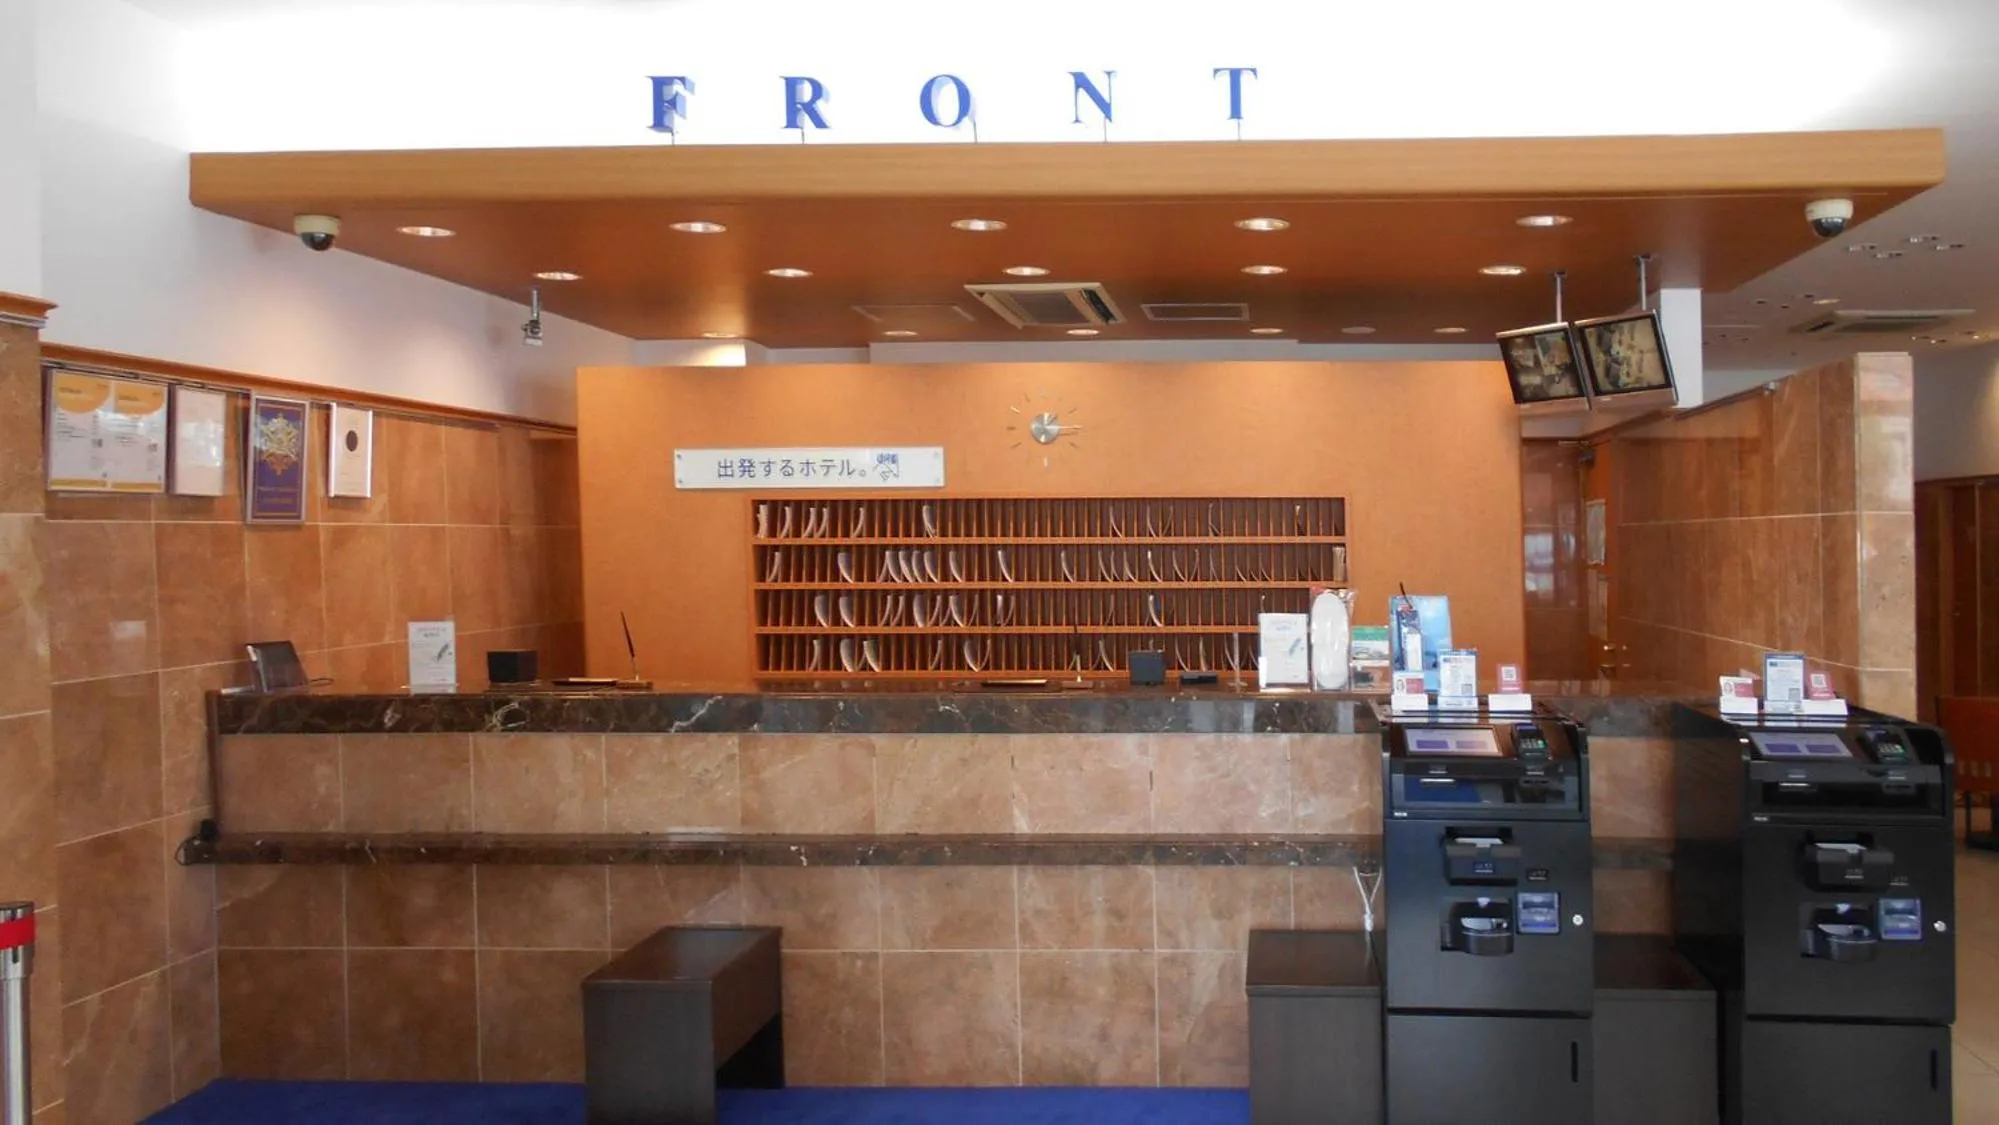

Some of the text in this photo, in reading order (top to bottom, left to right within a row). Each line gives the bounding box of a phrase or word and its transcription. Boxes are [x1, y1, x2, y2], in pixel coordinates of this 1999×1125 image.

[647, 67, 1258, 131] FRONT
[716, 458, 867, 478] 出発するホテル。
